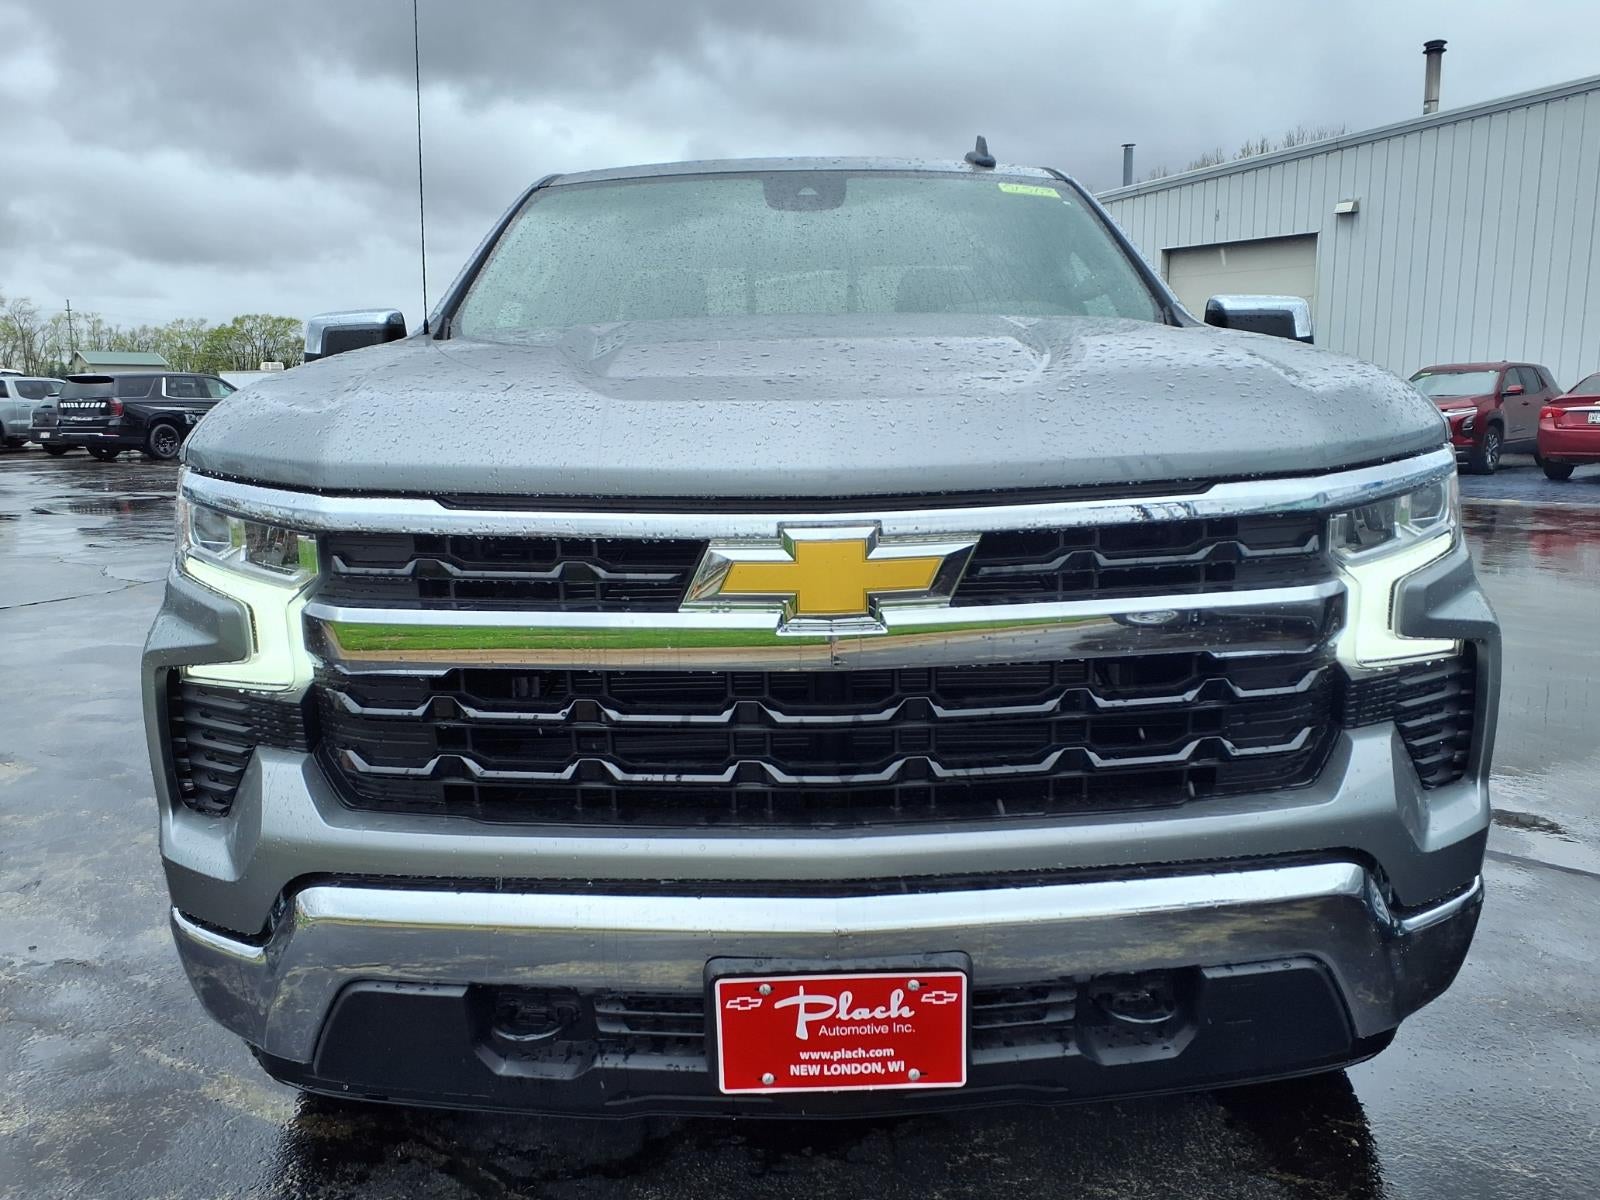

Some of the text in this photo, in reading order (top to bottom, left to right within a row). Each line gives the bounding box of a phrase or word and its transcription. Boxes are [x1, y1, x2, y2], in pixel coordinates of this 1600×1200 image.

[774, 985, 915, 1040] Plach
[818, 1021, 916, 1036] Automotive Inc.
[799, 1048, 895, 1060] www.plach.com
[790, 1060, 905, 1076] NEW LONDON, WI
